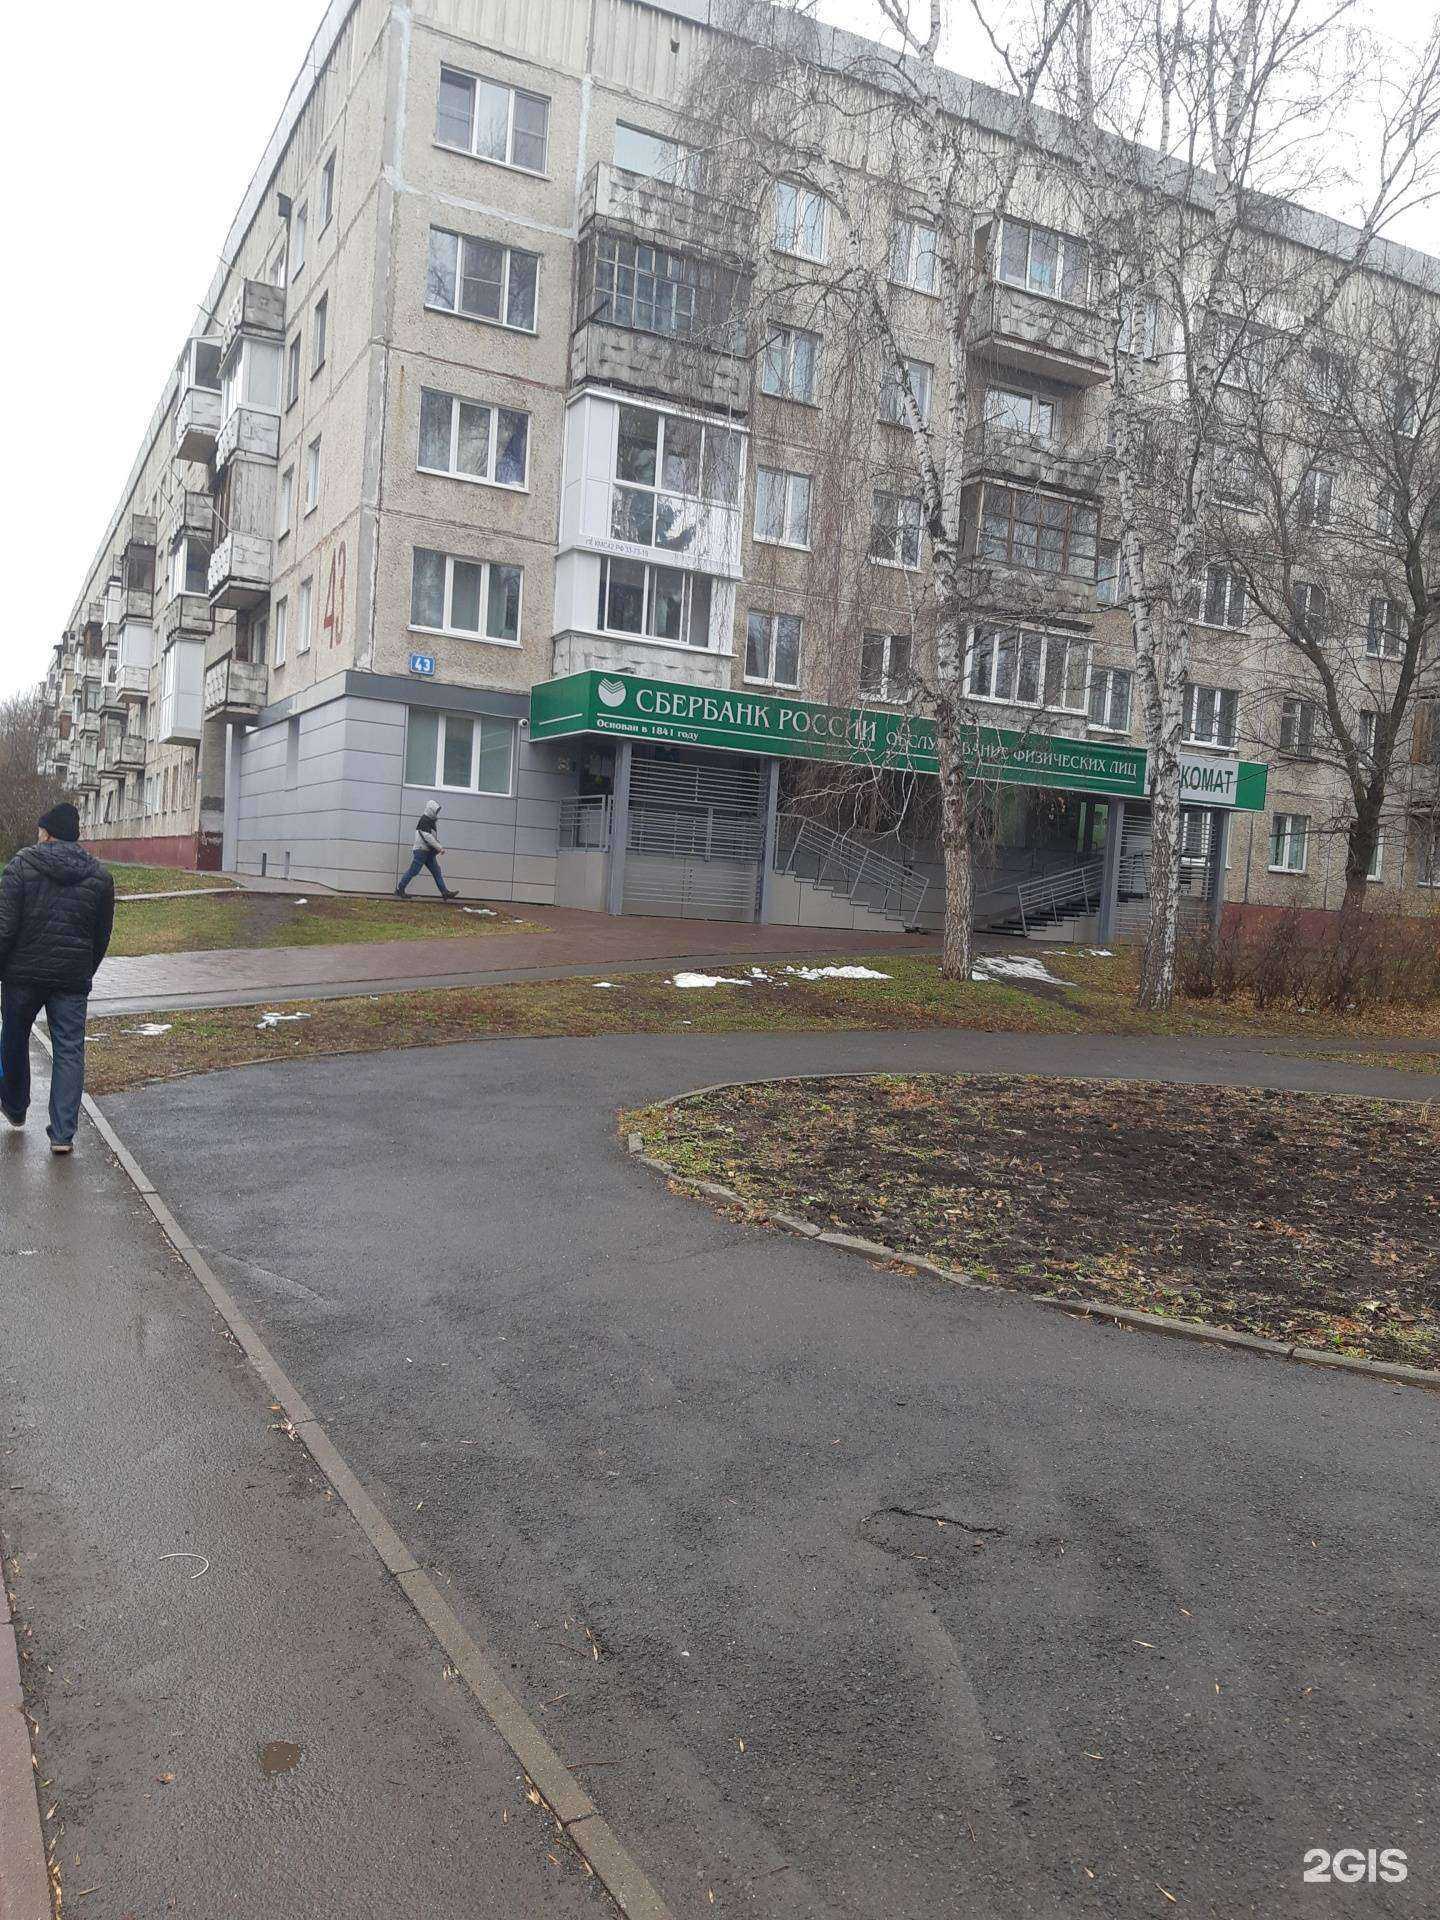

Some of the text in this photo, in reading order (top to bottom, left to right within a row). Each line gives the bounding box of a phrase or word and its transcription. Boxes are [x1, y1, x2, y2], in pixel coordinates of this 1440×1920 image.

[323, 541, 347, 650] 43
[414, 657, 431, 671] 43
[596, 718, 699, 741] Основан в 1841 году
[636, 689, 877, 742] СБЕРБАНК РОССИИ
[1013, 749, 1106, 773] ФИЗИЧЕСКИХ
[1109, 760, 1137, 778] ЛИЦ
[1148, 762, 1234, 795] КОМАТ
